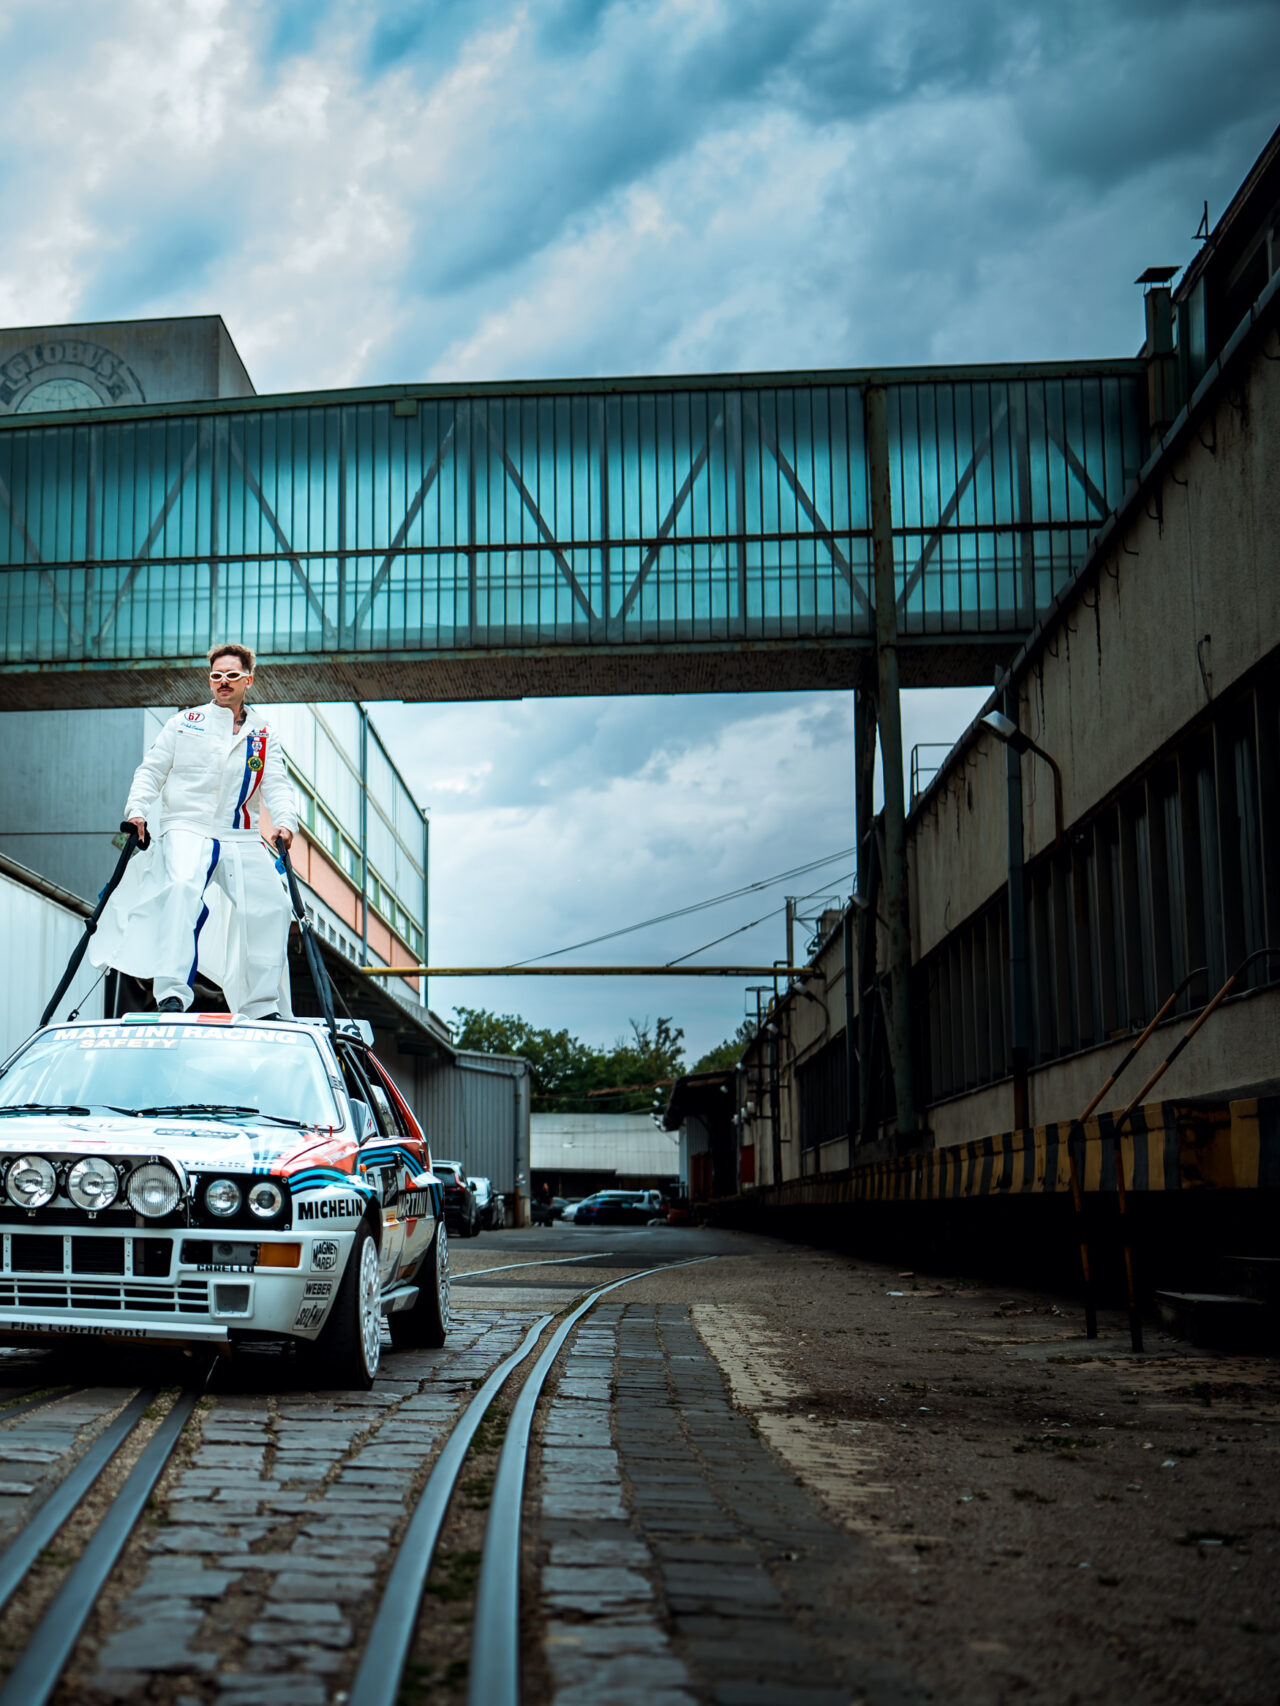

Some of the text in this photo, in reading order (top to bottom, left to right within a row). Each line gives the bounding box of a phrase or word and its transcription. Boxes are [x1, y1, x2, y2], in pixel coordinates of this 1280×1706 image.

[4, 341, 120, 380] GLOBUS
[188, 712, 201, 721] 67
[53, 1026, 177, 1041] MARTINI
[183, 1026, 298, 1044] RACING
[79, 1038, 178, 1049] SAFETY
[297, 1199, 363, 1220] MICHELIN
[305, 1283, 332, 1296] WEBER
[10, 1321, 147, 1338] Fiat Lubrificanti
